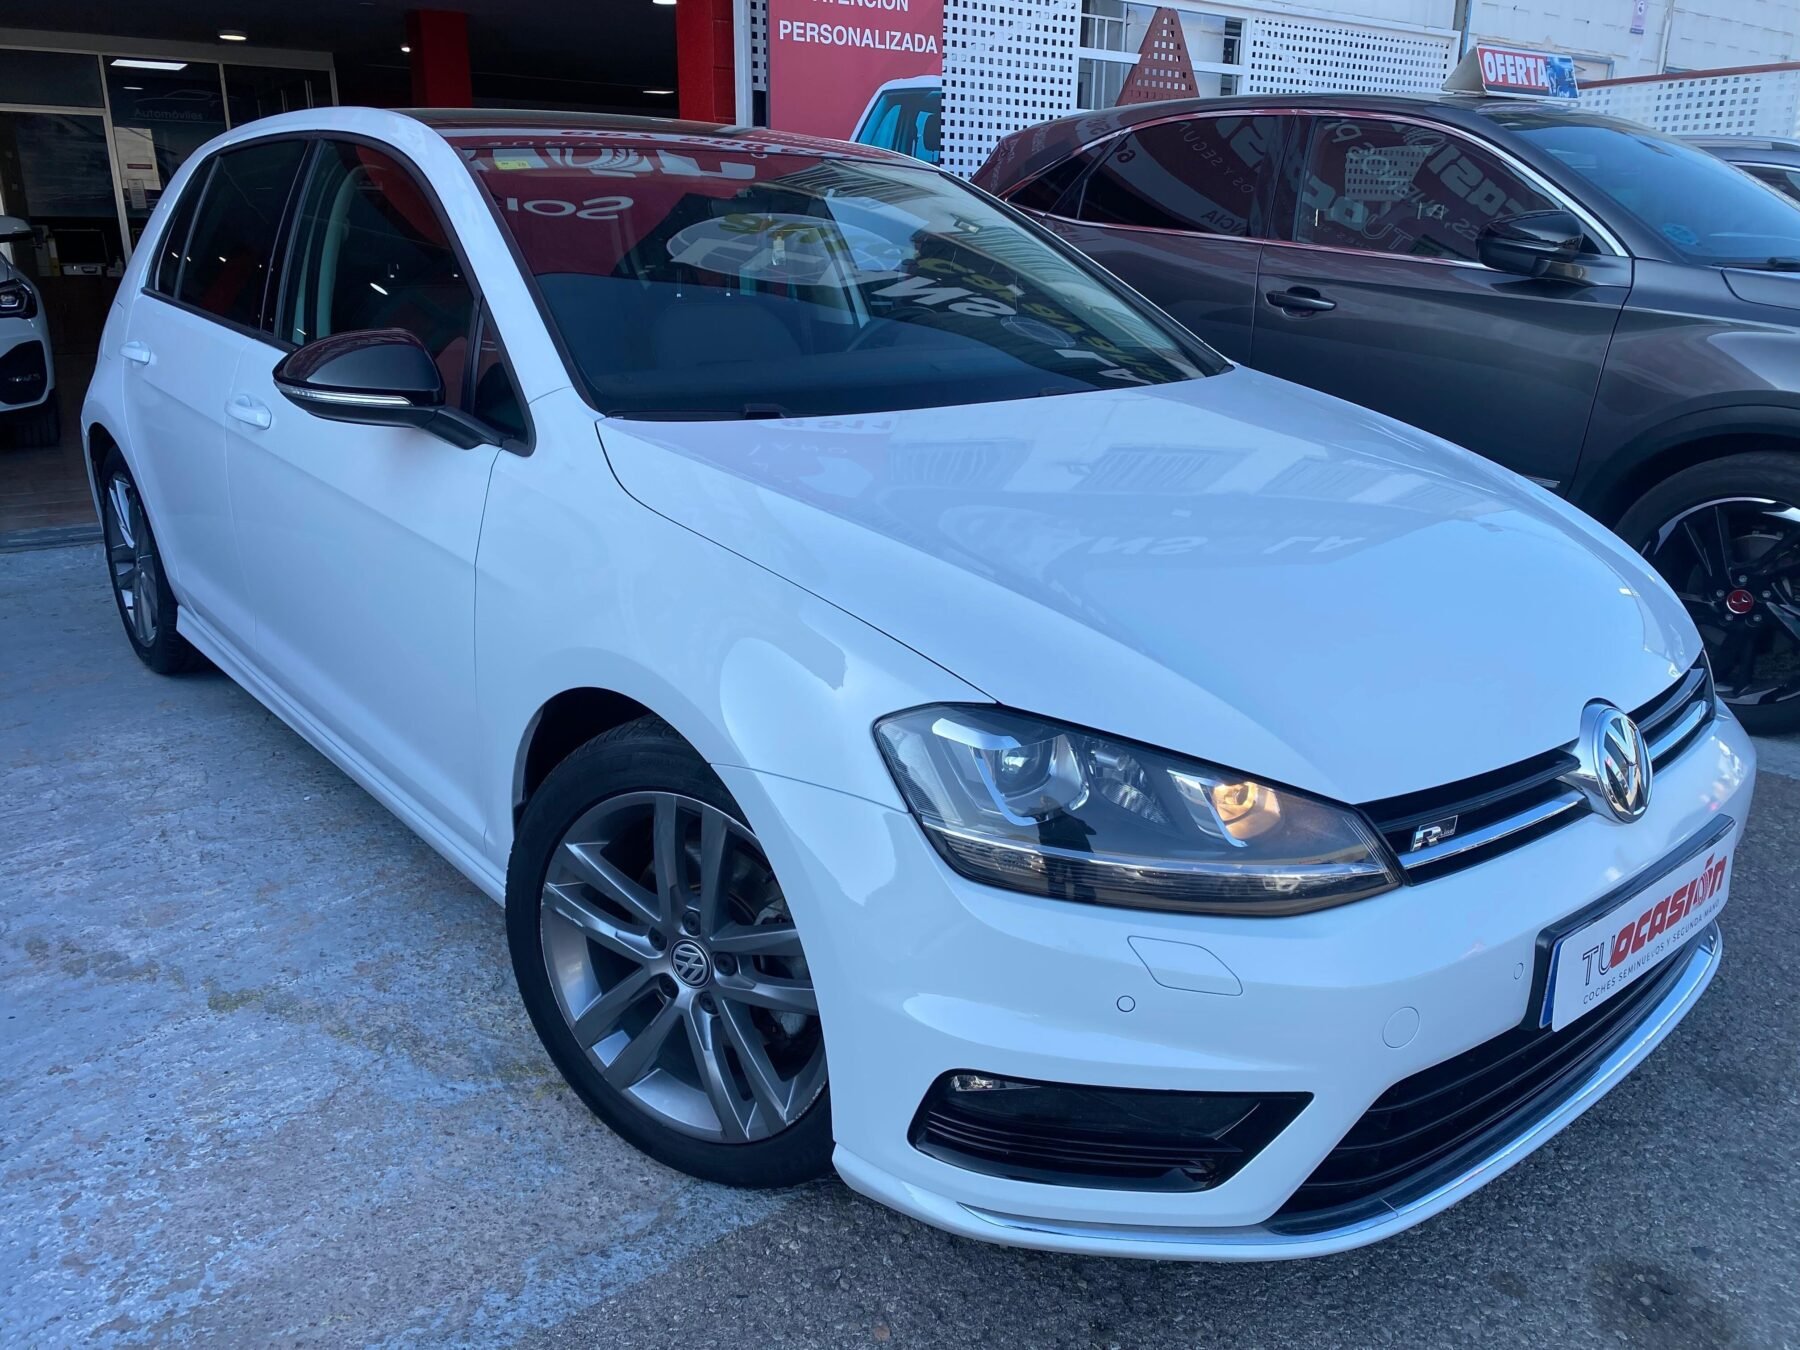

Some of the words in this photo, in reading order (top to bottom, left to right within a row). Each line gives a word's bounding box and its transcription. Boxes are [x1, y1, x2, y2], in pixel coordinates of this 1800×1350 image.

[779, 20, 938, 54] PERSONALIZADA
[1483, 51, 1549, 87] OFERTA
[135, 108, 203, 121] Automóviles
[1583, 978, 1616, 1005] COCHES
[1666, 939, 1672, 947] Y
[1672, 914, 1703, 942] SEGUNDA
[1704, 898, 1720, 918] MANO
